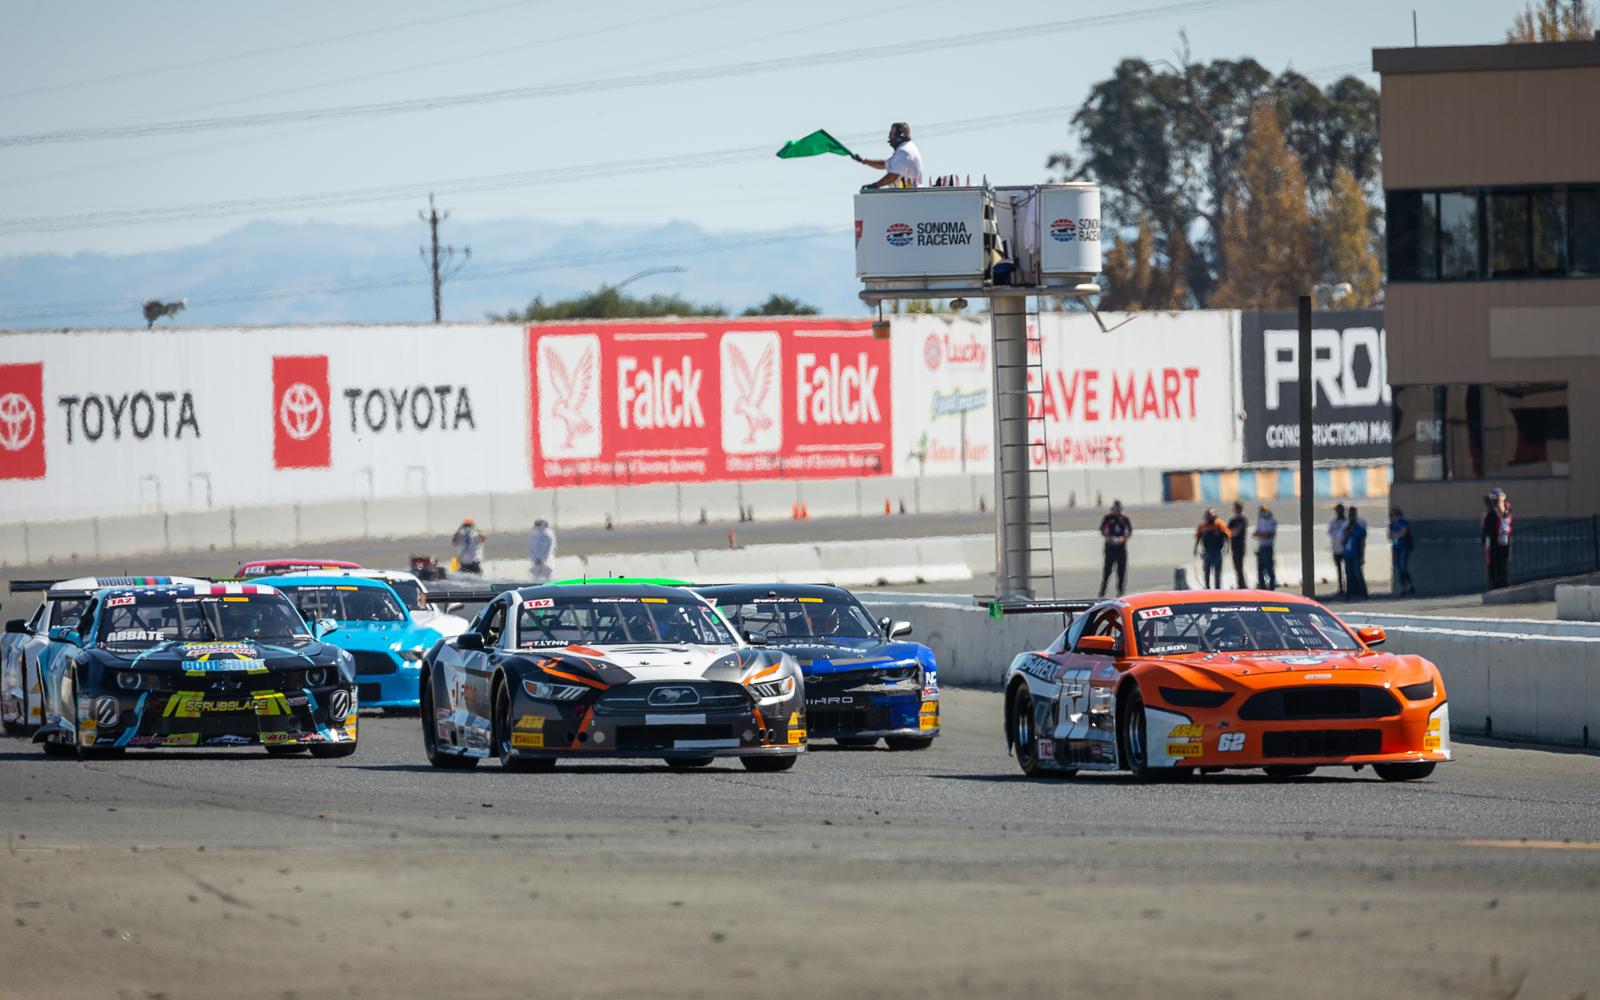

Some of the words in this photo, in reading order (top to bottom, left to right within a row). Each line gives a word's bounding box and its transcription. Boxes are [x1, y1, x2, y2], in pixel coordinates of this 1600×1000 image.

[916, 221, 967, 234] SONOMA
[1078, 218, 1100, 230] SONO
[917, 232, 972, 247] RACEWAY
[1079, 230, 1100, 242] RACE
[1264, 327, 1391, 410] PRO
[617, 355, 705, 430] Falck
[797, 352, 881, 425] Falck
[1111, 367, 1199, 421] MART
[344, 385, 476, 433] TOYOTA
[59, 391, 200, 444] TOYOTA
[1266, 421, 1368, 448] CONSRUCTION
[1369, 420, 1391, 444] MA
[1033, 436, 1124, 466] OMPANIES
[528, 600, 550, 608] TA2
[1144, 609, 1167, 618] TA2
[107, 630, 164, 642] ABBATE
[1149, 644, 1187, 654] NELSON
[186, 700, 268, 712] SCRUBBLADE
[805, 696, 854, 706] ARO
[1217, 732, 1246, 752] 62
